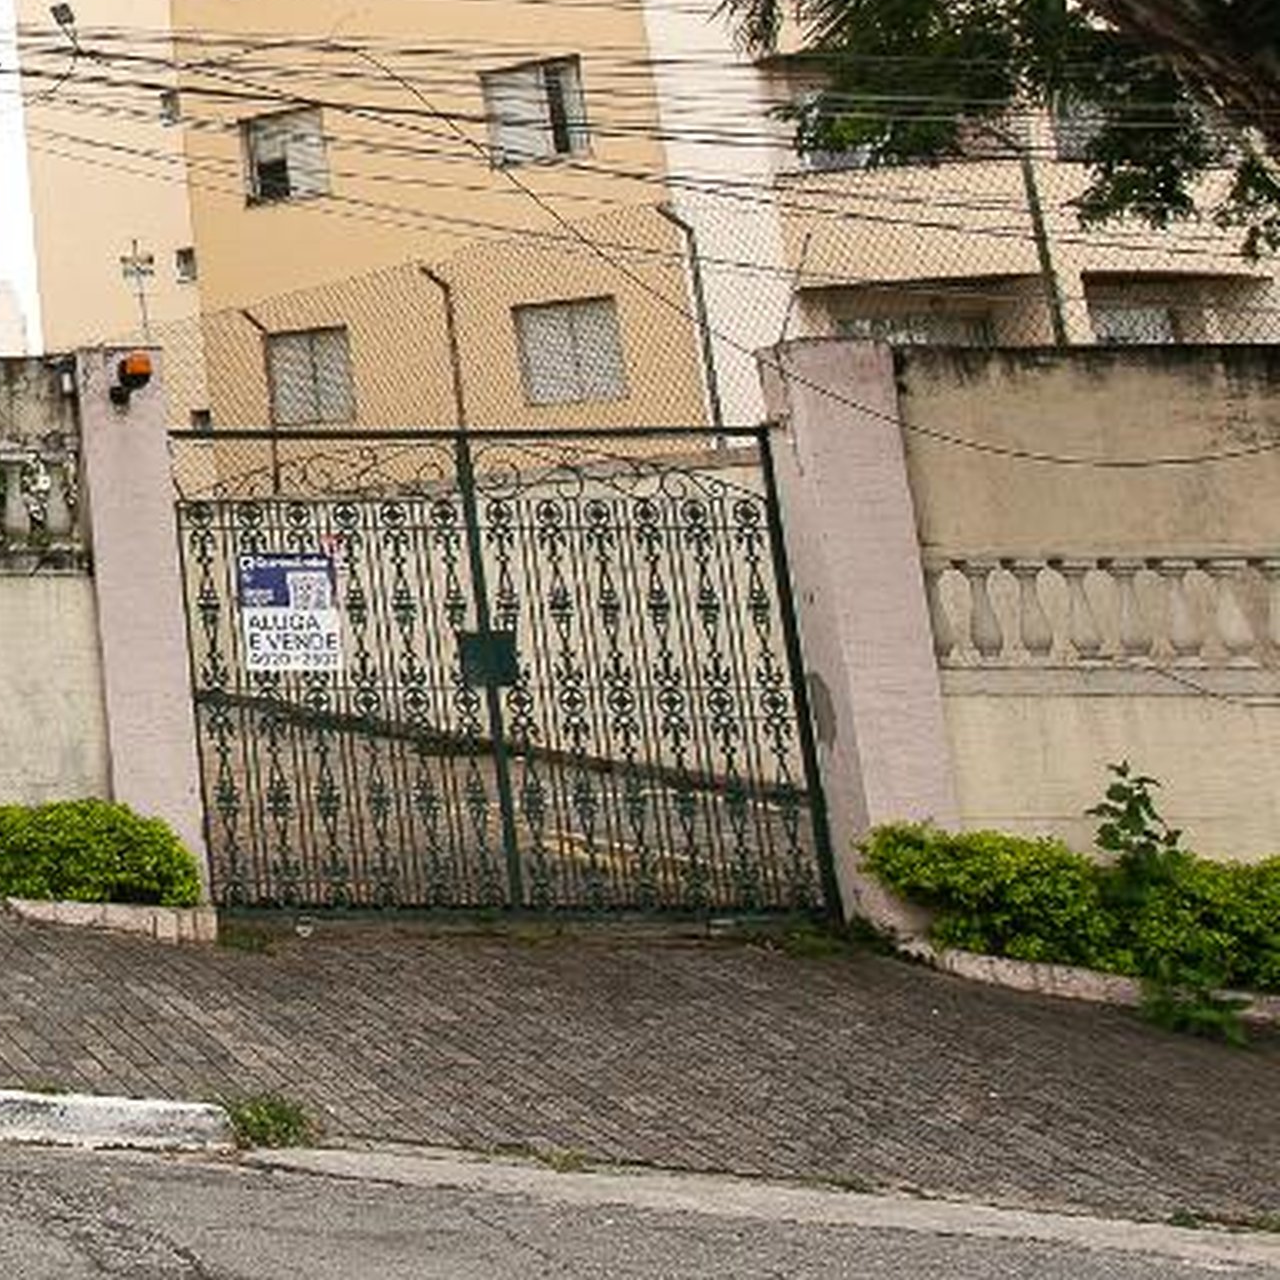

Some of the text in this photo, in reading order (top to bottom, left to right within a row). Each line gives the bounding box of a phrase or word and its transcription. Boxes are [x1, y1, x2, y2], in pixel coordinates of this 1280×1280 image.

[249, 613, 321, 631] ALUGA
[249, 632, 338, 651] E VENDE
